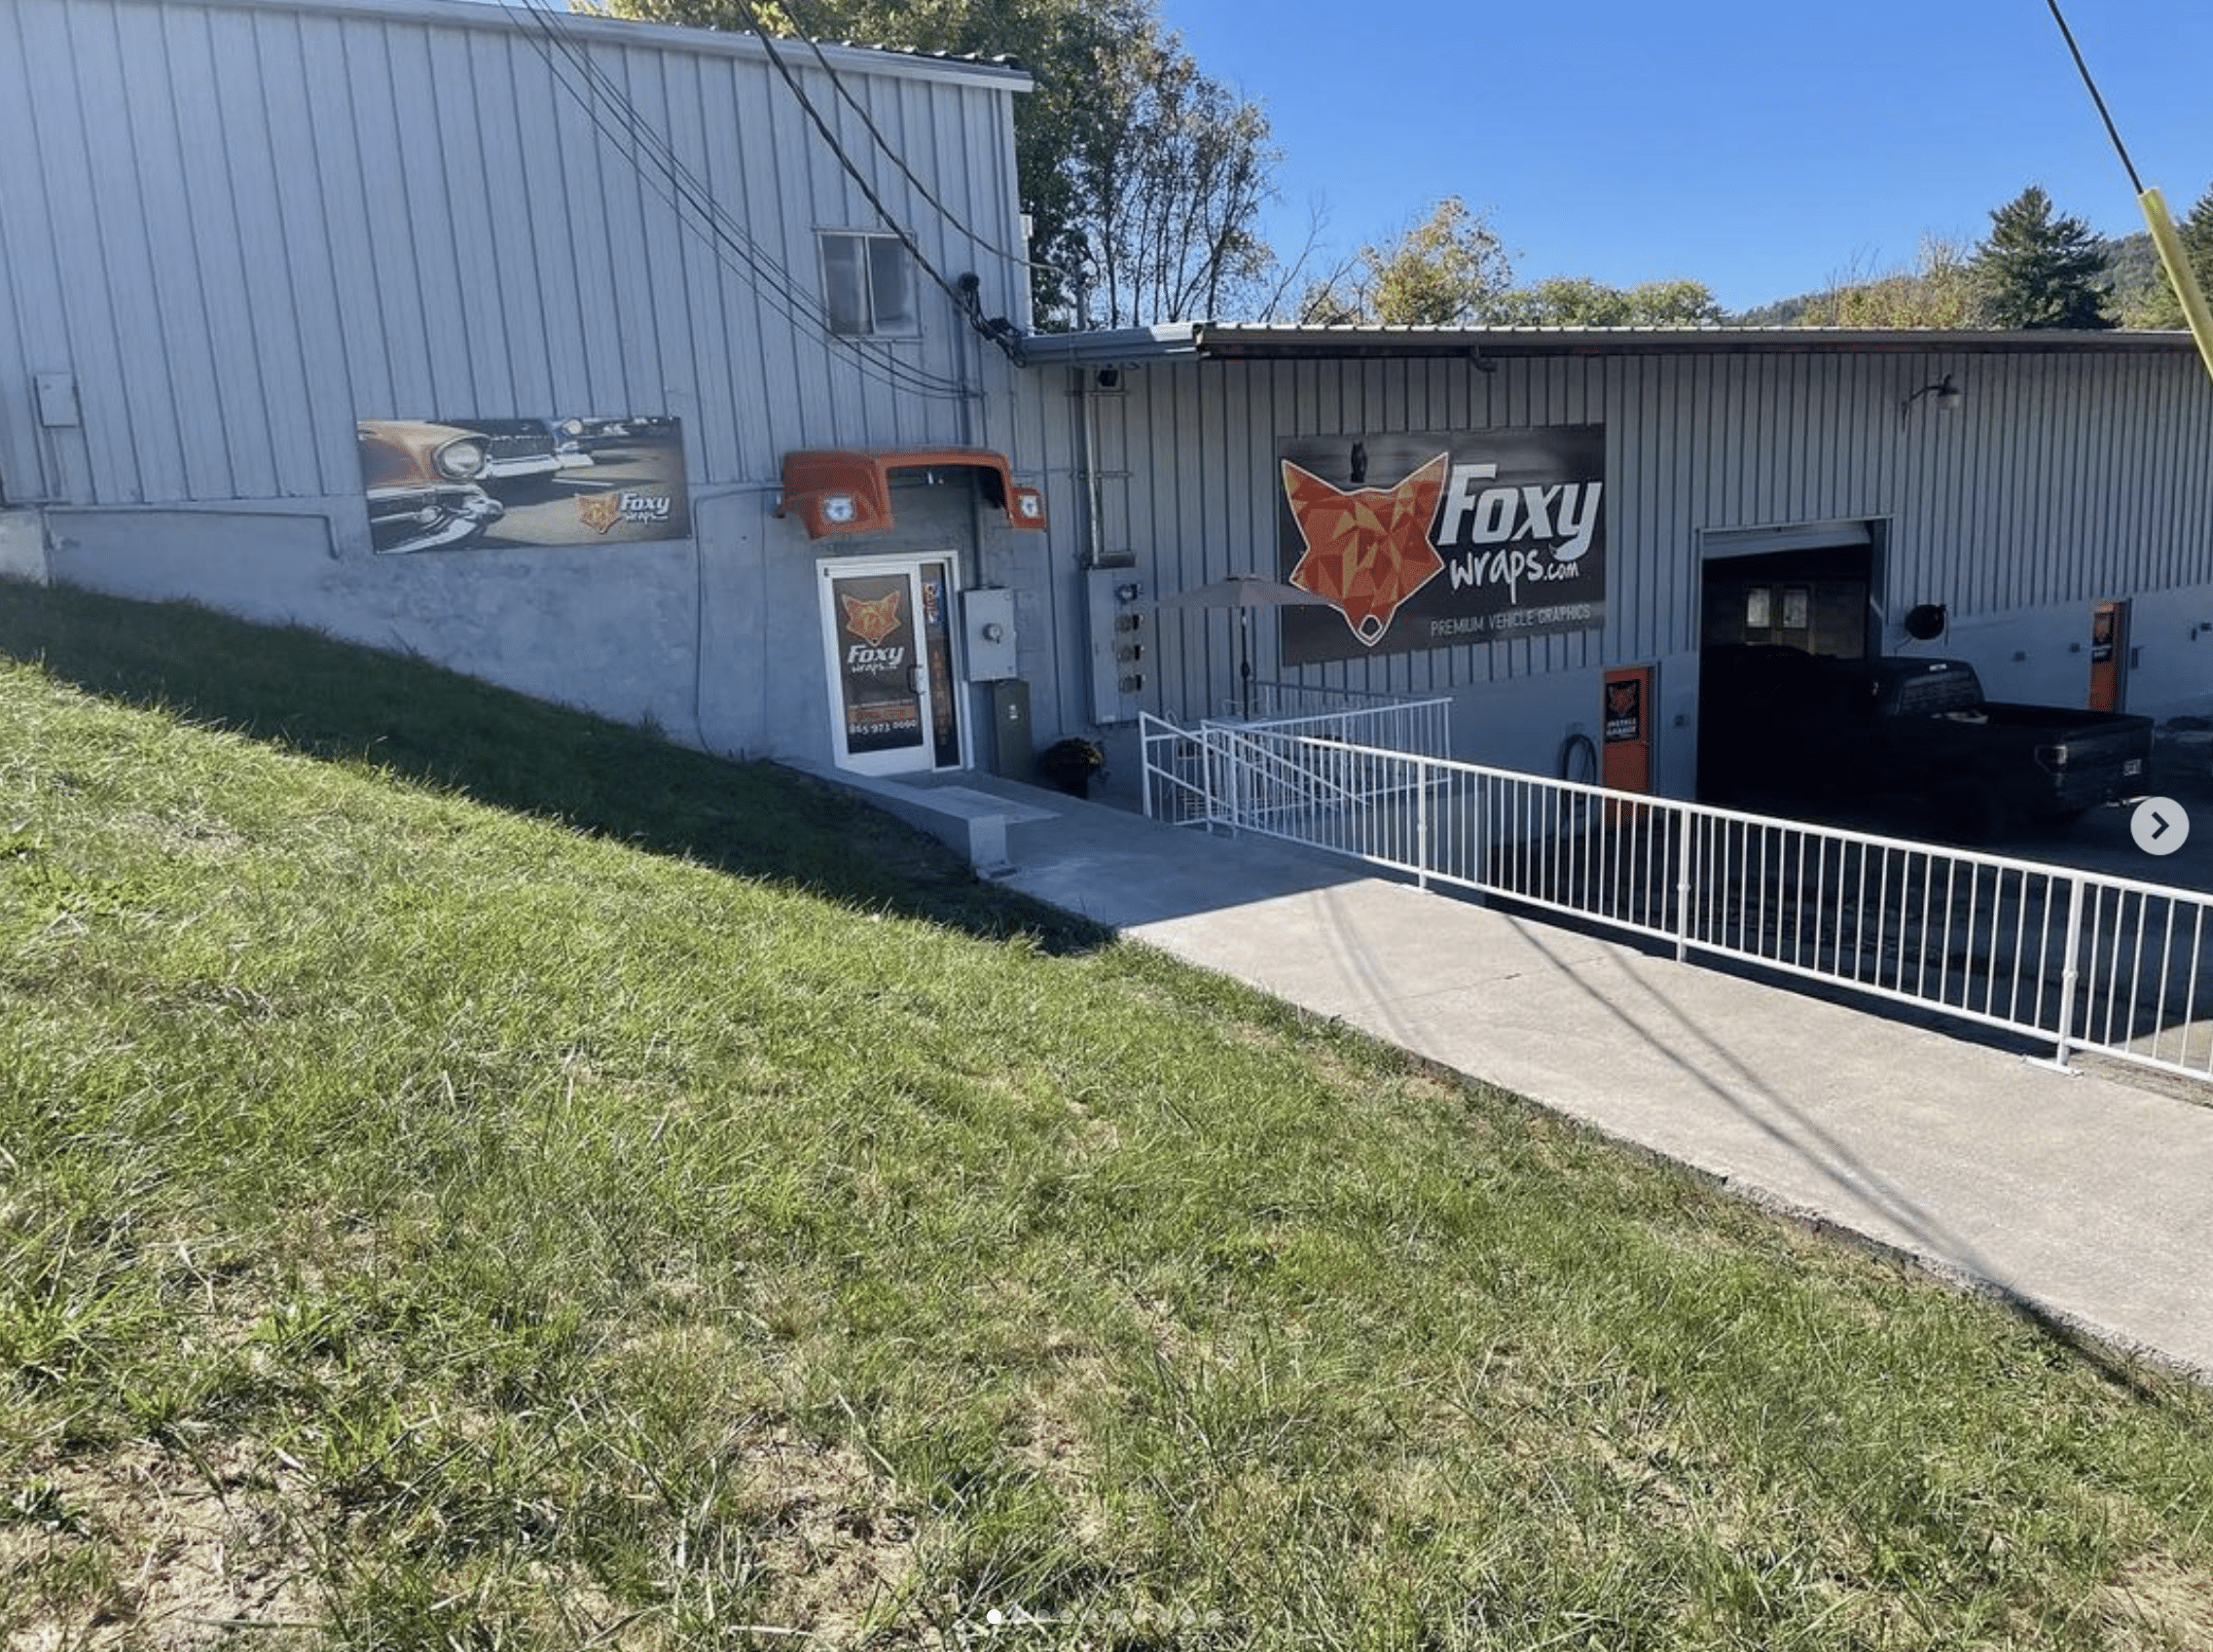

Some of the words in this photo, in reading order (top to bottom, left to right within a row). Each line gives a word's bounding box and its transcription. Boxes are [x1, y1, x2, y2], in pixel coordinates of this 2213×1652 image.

[620, 492, 671, 516] Foxy
[1436, 463, 1603, 562] Foxy
[1449, 549, 1578, 605] wraps.com
[1430, 617, 1485, 637] PREMIUM
[1488, 610, 1535, 629] VEHICLE
[1538, 603, 1591, 624] GRAPHICS
[847, 644, 905, 665] Foxy
